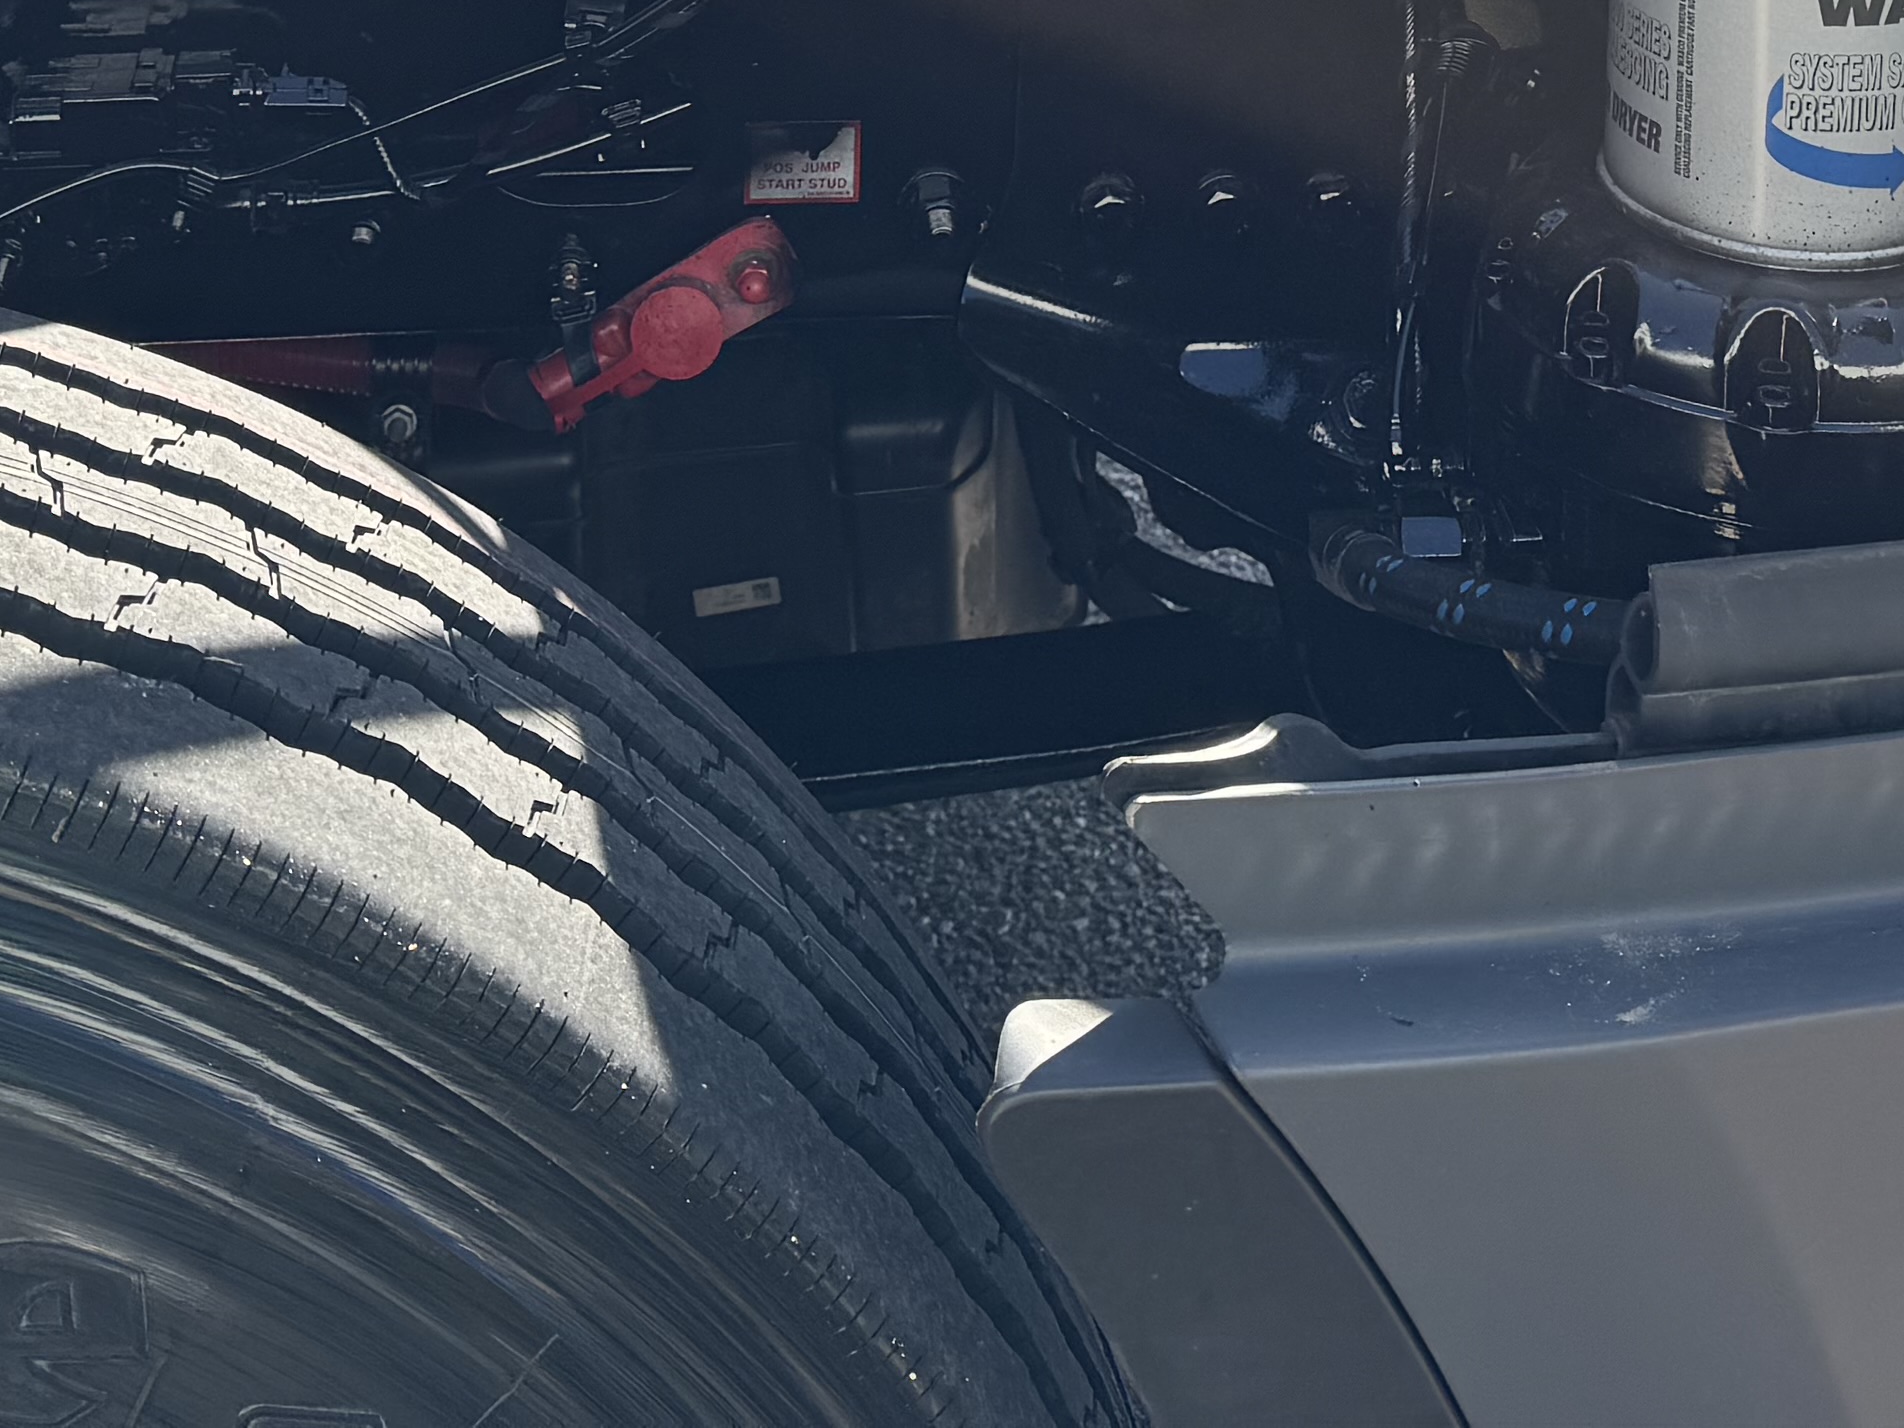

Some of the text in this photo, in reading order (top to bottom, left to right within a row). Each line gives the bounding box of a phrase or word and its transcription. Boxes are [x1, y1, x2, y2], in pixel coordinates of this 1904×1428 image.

[1788, 52, 1883, 92] SYSTEM
[1612, 91, 1663, 153] DRYER
[1785, 92, 1896, 132] PREMIUM
[757, 177, 848, 190] START STUD
[802, 161, 841, 174] JUMP
